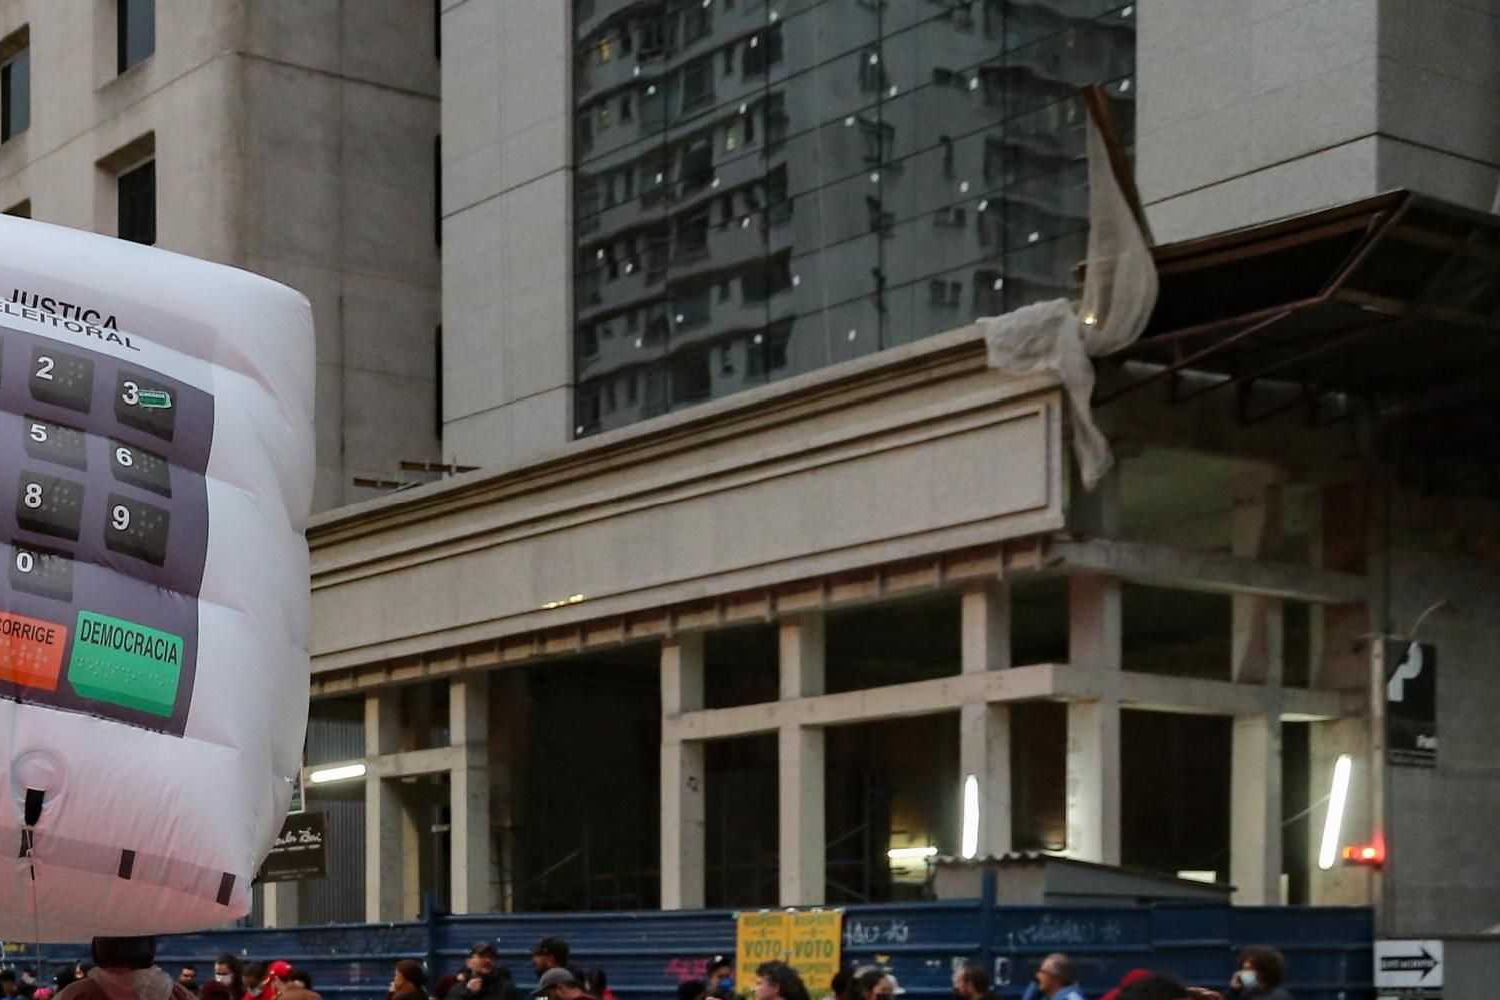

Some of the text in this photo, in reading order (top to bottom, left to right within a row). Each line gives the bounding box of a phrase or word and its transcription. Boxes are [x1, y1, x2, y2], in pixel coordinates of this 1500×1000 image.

[35, 356, 55, 381] 2
[122, 381, 139, 406] 3
[30, 423, 48, 443] 5
[115, 447, 133, 467] 6
[24, 483, 43, 508] 8
[112, 504, 130, 531] 9
[16, 552, 34, 573] 0
[80, 619, 178, 665] DEMOCRACIA
[744, 940, 782, 958] VOTO
[795, 940, 834, 958] VOTO
